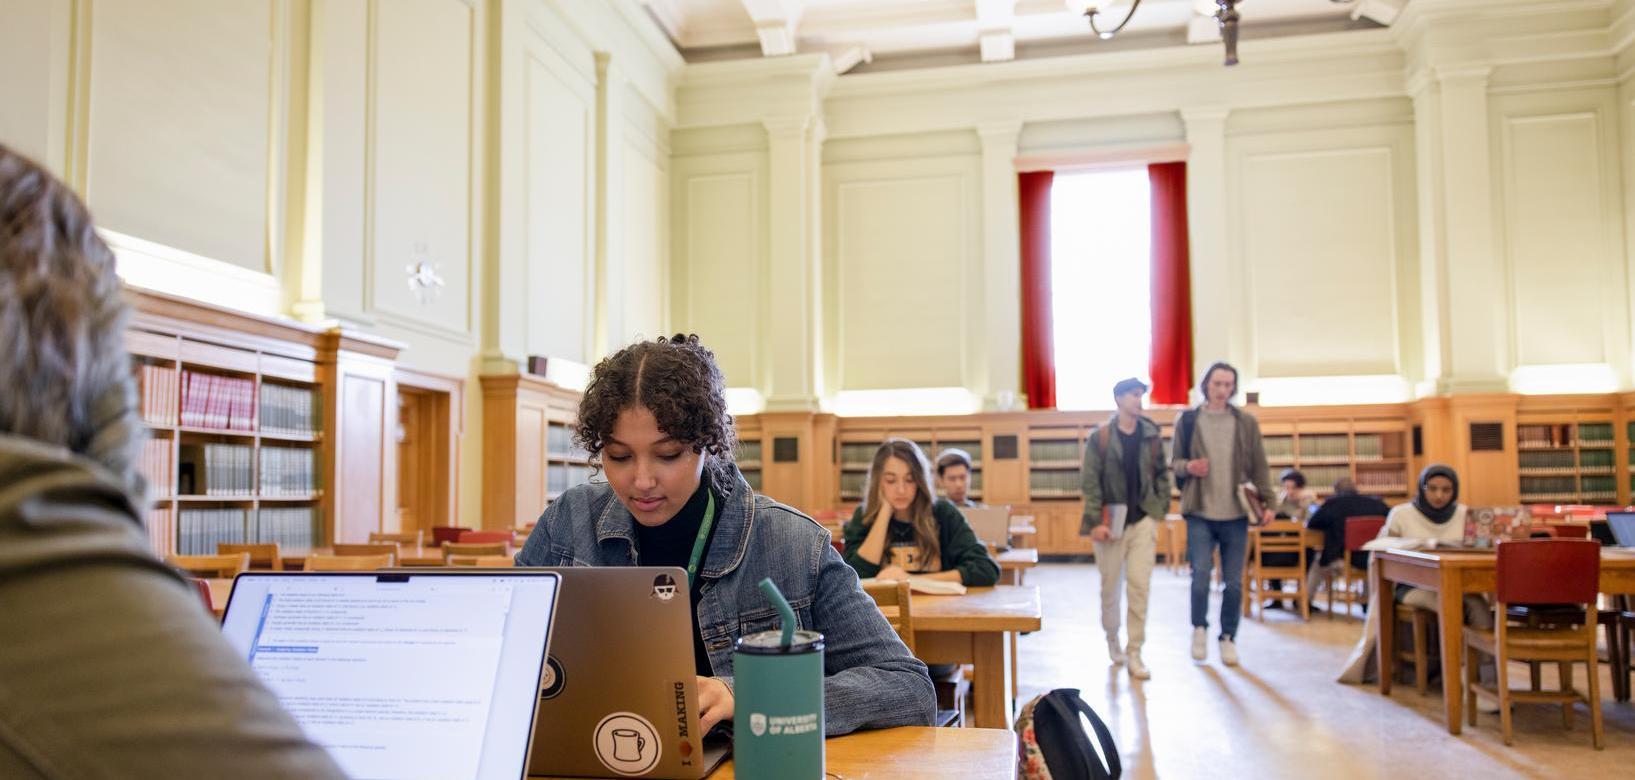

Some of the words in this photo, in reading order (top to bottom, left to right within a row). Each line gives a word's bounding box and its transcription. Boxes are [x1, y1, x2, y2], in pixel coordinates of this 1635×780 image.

[674, 682, 688, 737] MAKING
[769, 713, 817, 725] UNIVERSITY
[769, 725, 781, 735] OF
[783, 723, 817, 735] ALBERTA
